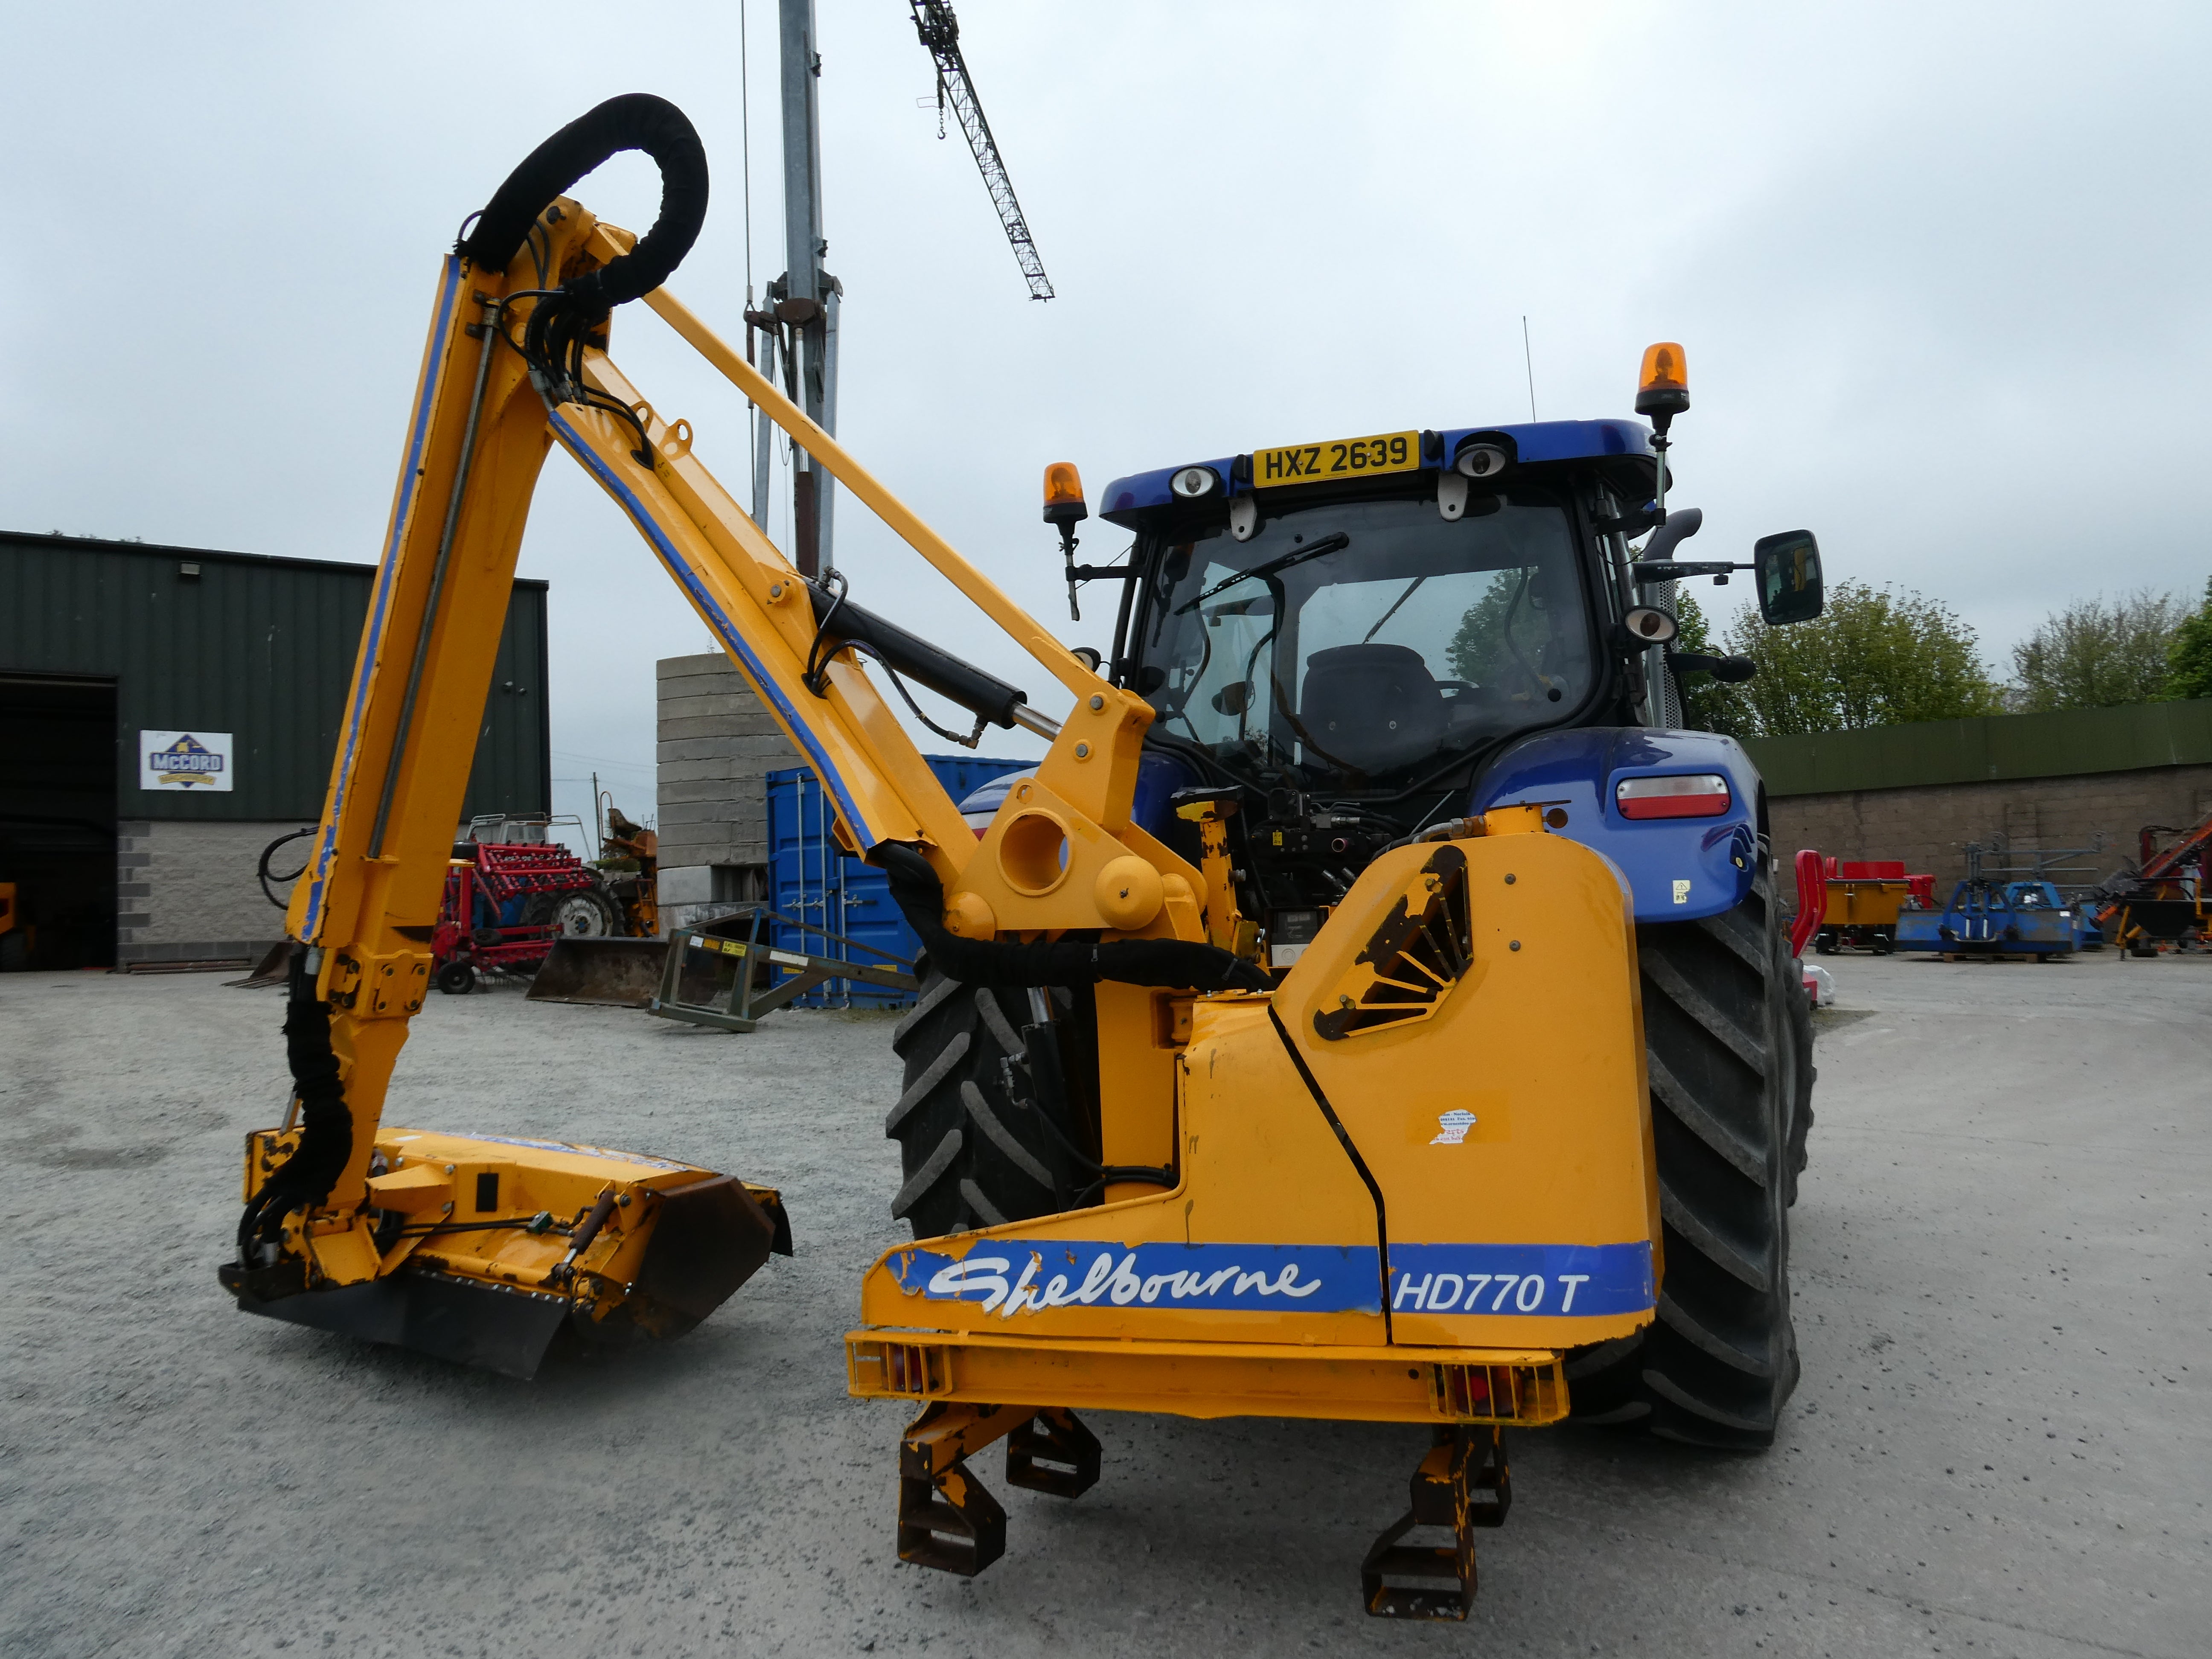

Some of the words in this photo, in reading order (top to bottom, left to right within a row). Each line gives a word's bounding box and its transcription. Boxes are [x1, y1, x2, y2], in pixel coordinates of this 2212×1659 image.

[1266, 447, 1321, 479] HXZ
[1330, 437, 1407, 472] 2639
[928, 1252, 1322, 1318] Shelbourne
[1393, 1272, 1545, 1312] HD770
[1558, 1274, 1590, 1313] T
